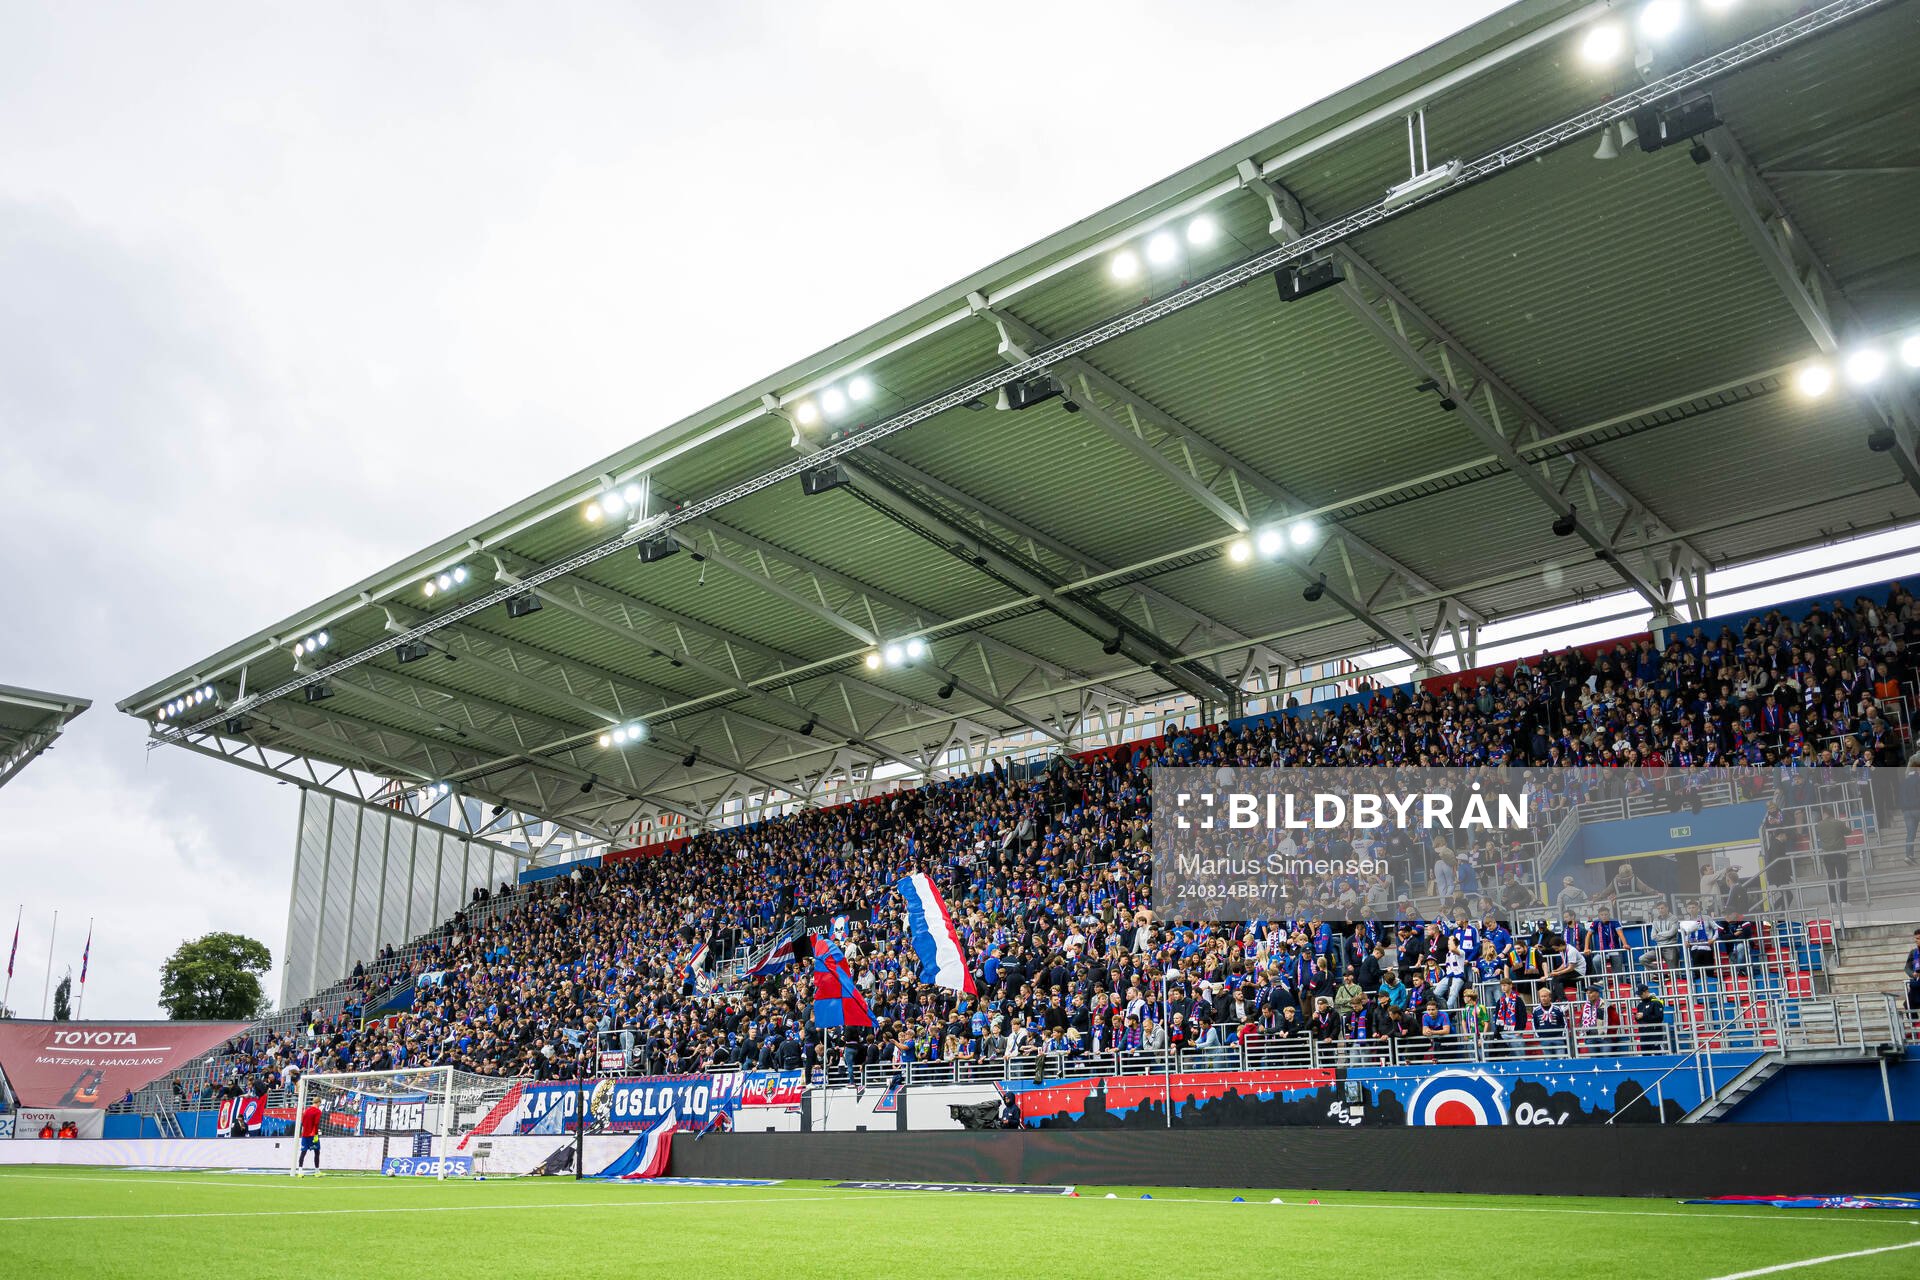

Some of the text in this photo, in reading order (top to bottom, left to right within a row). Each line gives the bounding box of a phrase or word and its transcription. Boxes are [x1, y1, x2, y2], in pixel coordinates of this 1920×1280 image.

[54, 1031, 137, 1045] TOYOTA
[35, 1056, 164, 1066] MATERIAL HANDLING
[614, 1088, 675, 1117] OSLO
[21, 1113, 56, 1121] TOYOTA
[364, 1103, 423, 1130] KOKOS
[415, 1161, 466, 1175] OBOS
